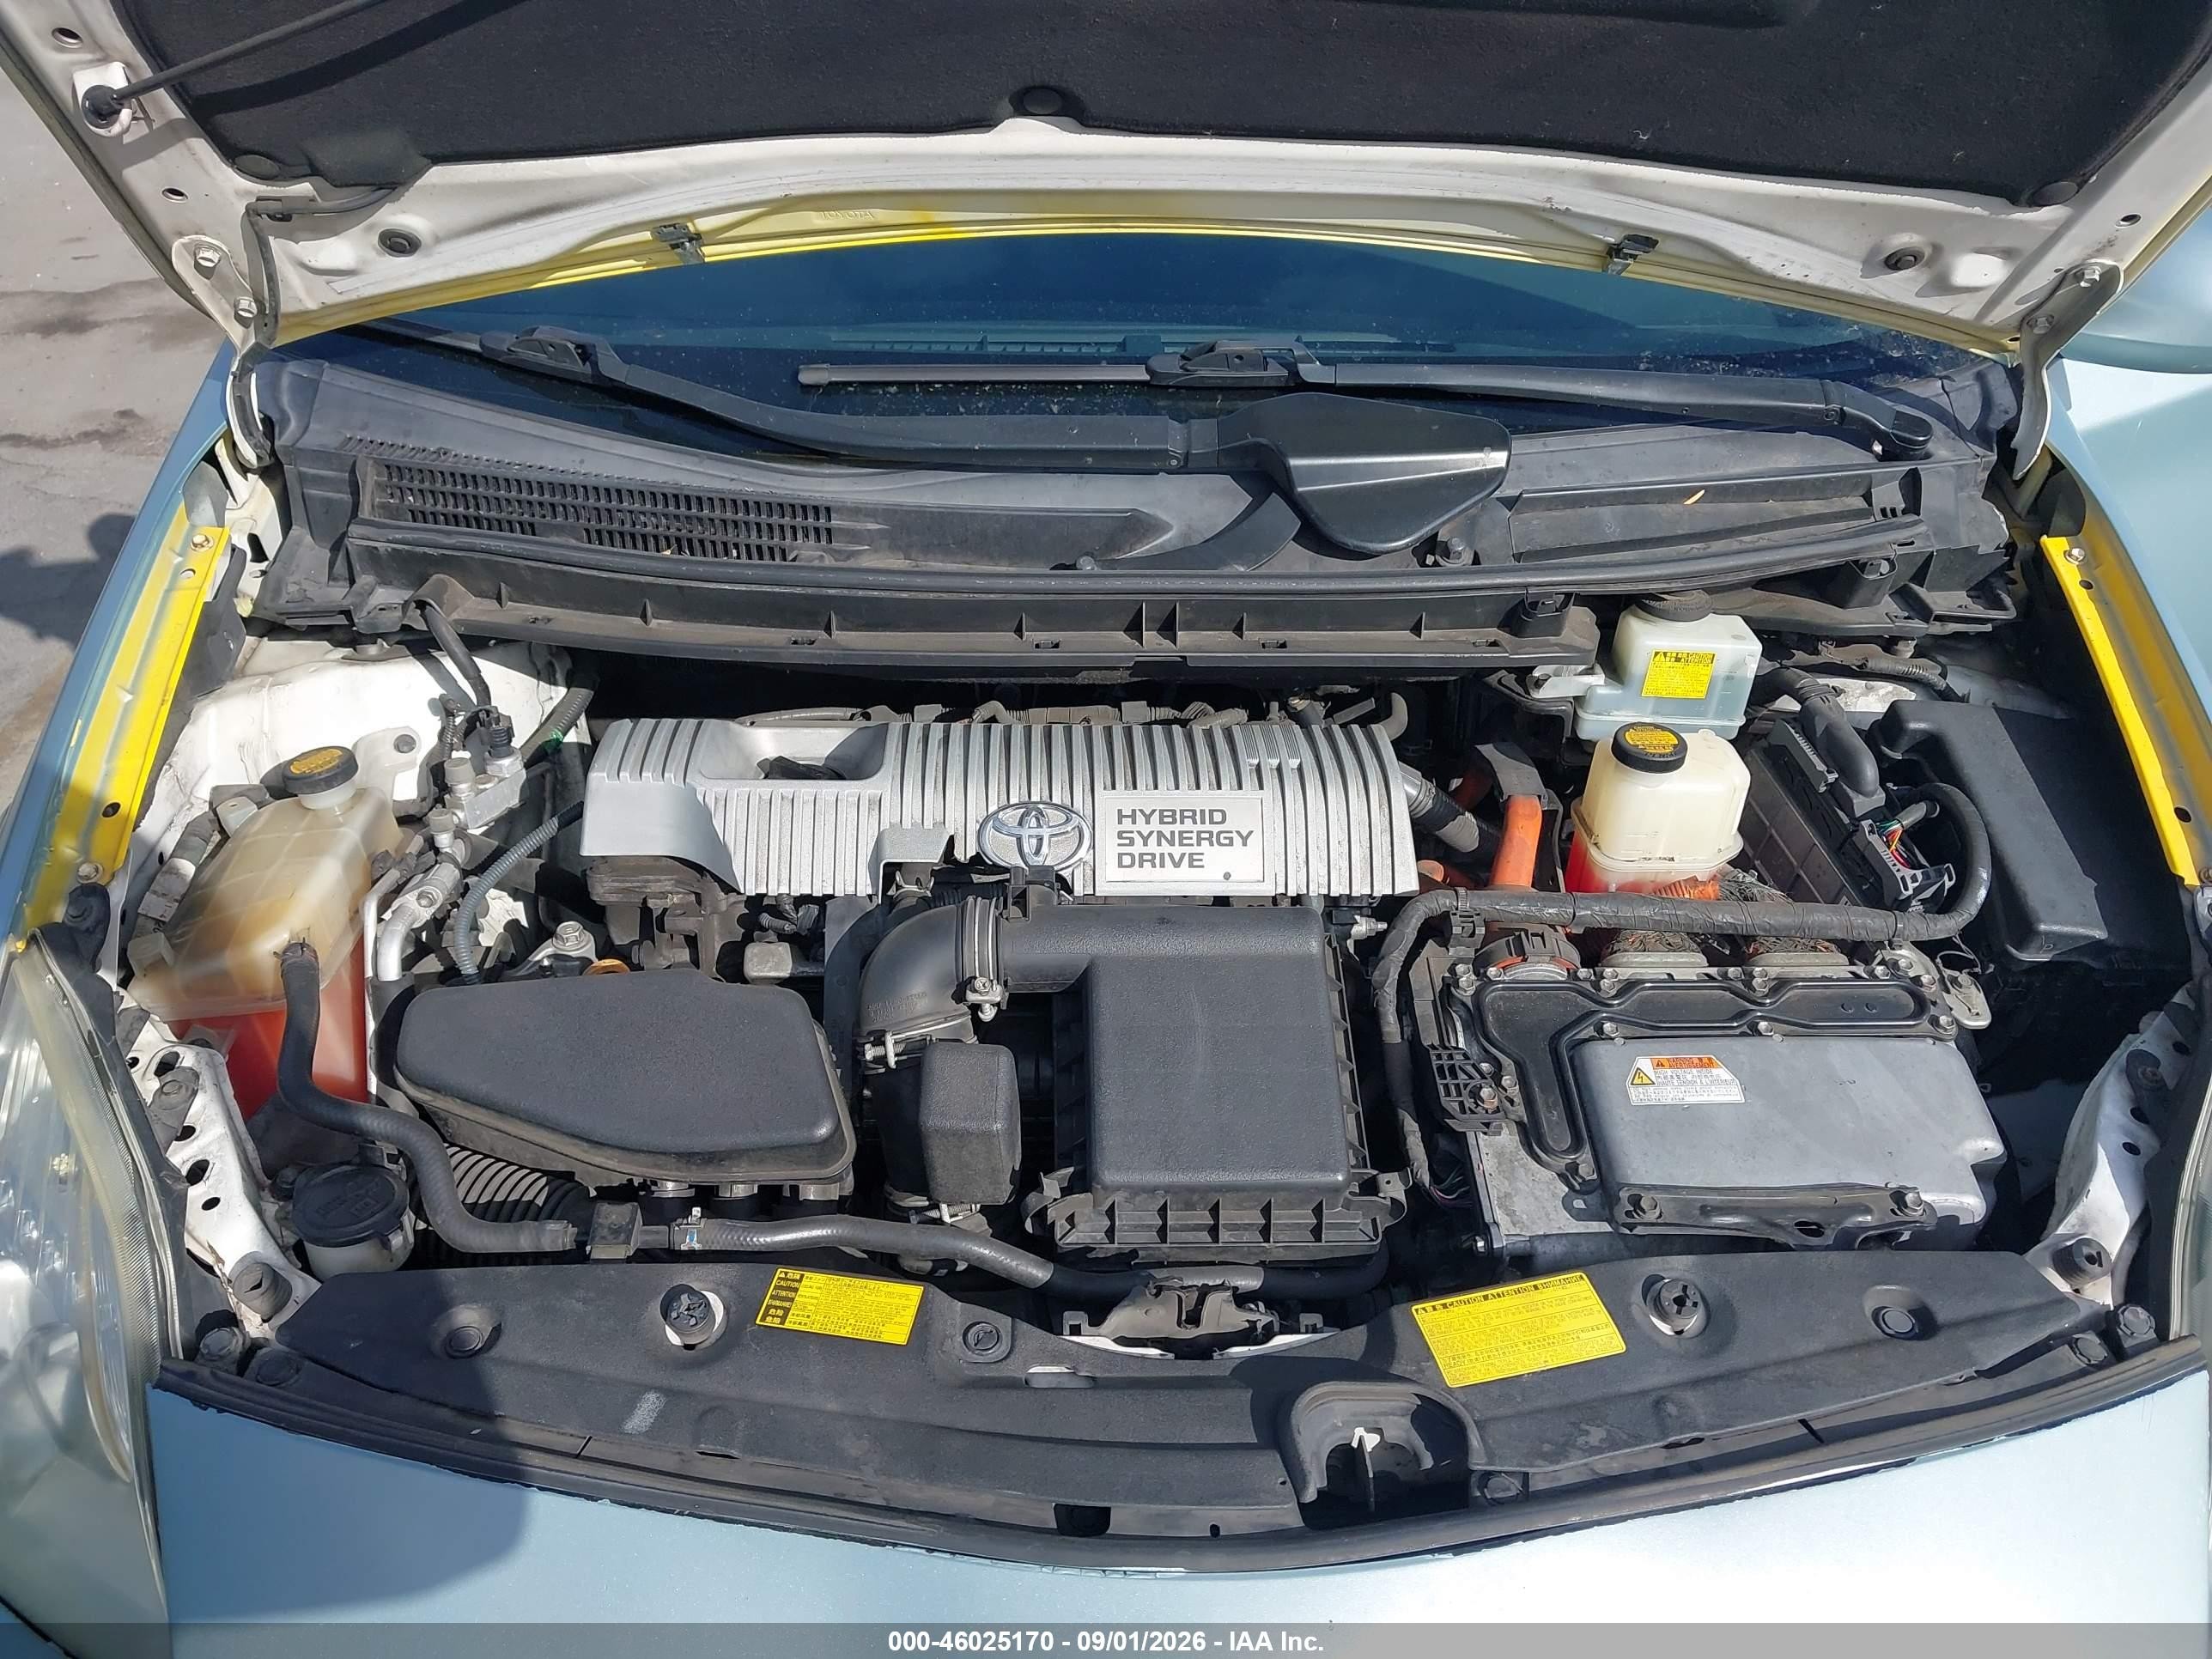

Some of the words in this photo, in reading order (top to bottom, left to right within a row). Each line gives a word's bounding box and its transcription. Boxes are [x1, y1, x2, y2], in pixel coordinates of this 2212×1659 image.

[820, 210, 874, 220] TOYOTA
[1117, 808, 1227, 825] HYBRID
[1117, 830, 1255, 847] SYNERGY
[1117, 853, 1205, 869] DRIVE
[775, 1279, 801, 1289] CAUTION
[1446, 1295, 1485, 1309] CAUTION
[1487, 1285, 1534, 1301] ATTENTION
[1538, 1275, 1583, 1290] ВНИМАНИЕ
[772, 1289, 797, 1298] ATTENTION
